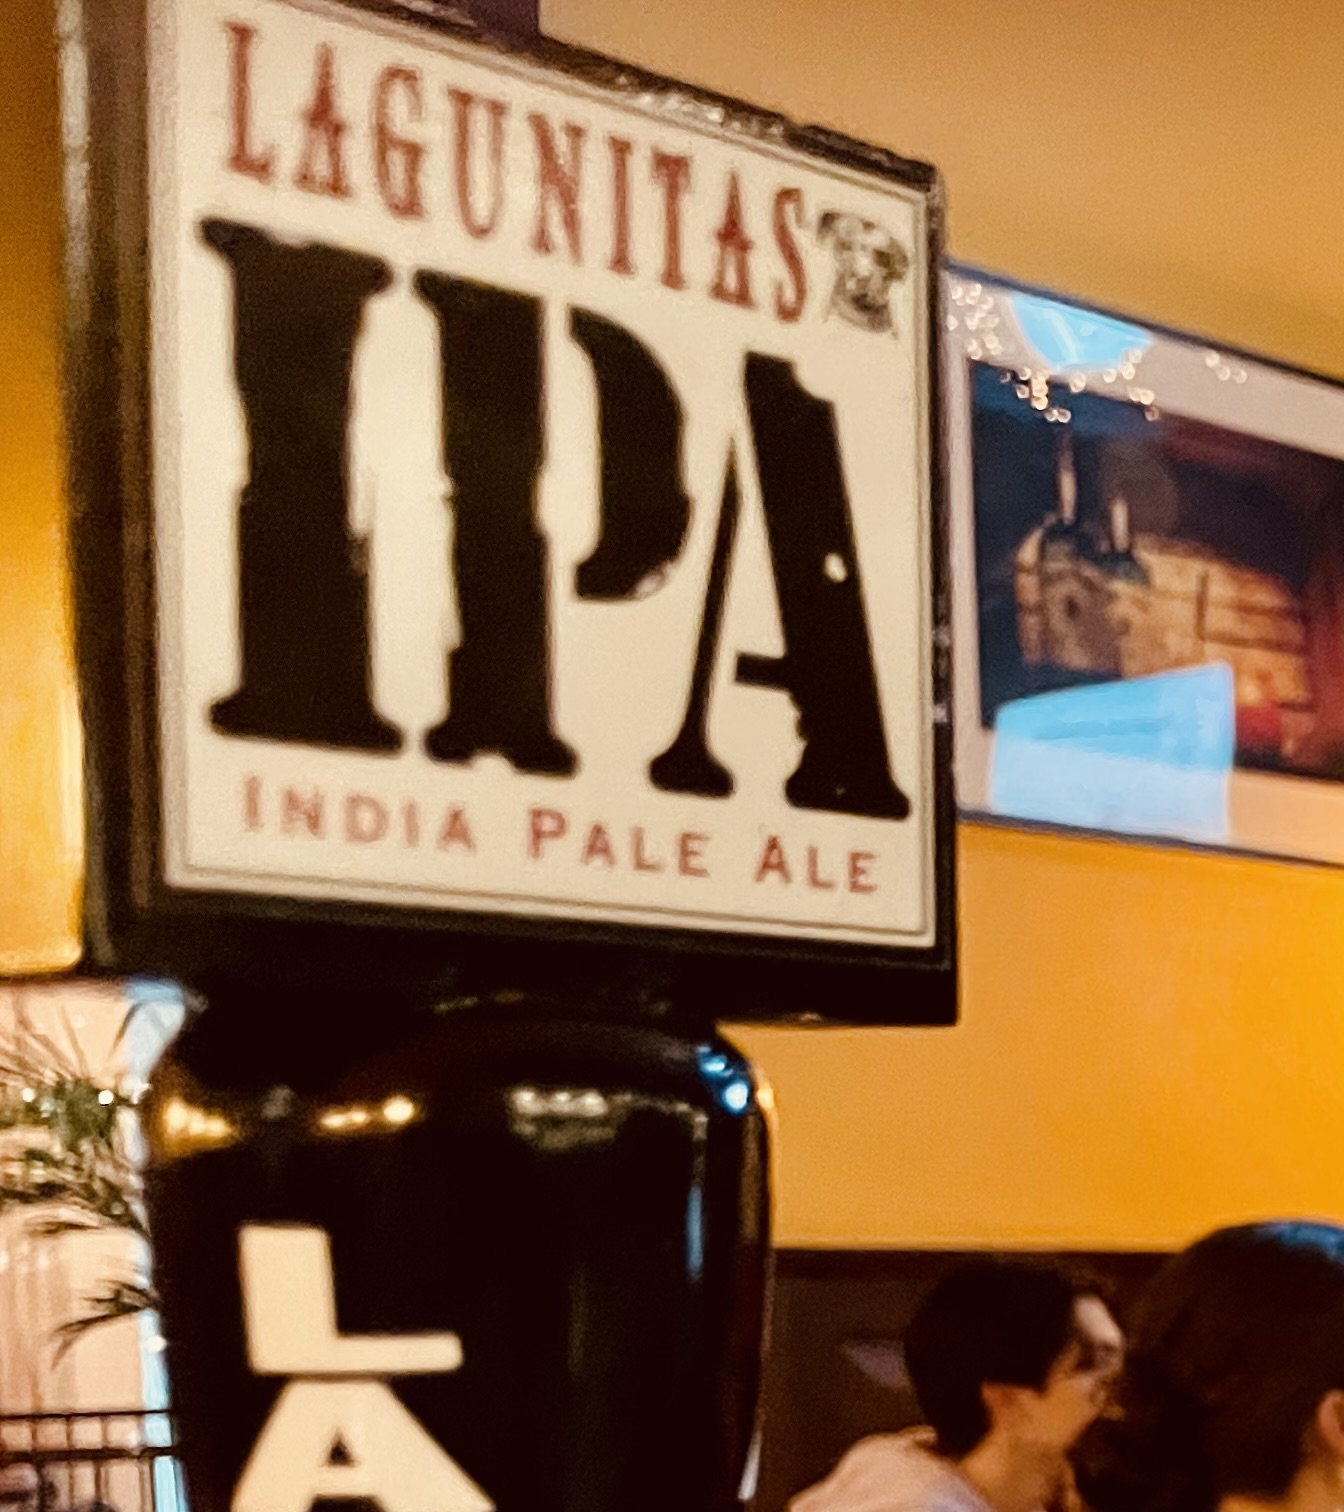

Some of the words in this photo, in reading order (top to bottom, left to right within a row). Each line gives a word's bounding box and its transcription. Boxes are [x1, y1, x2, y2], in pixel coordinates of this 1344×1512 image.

[222, 20, 810, 324] LAGUNITAS
[194, 215, 913, 821] IPA
[243, 773, 478, 854] INDIA
[528, 808, 712, 880] PALE
[754, 834, 880, 894] ALE
